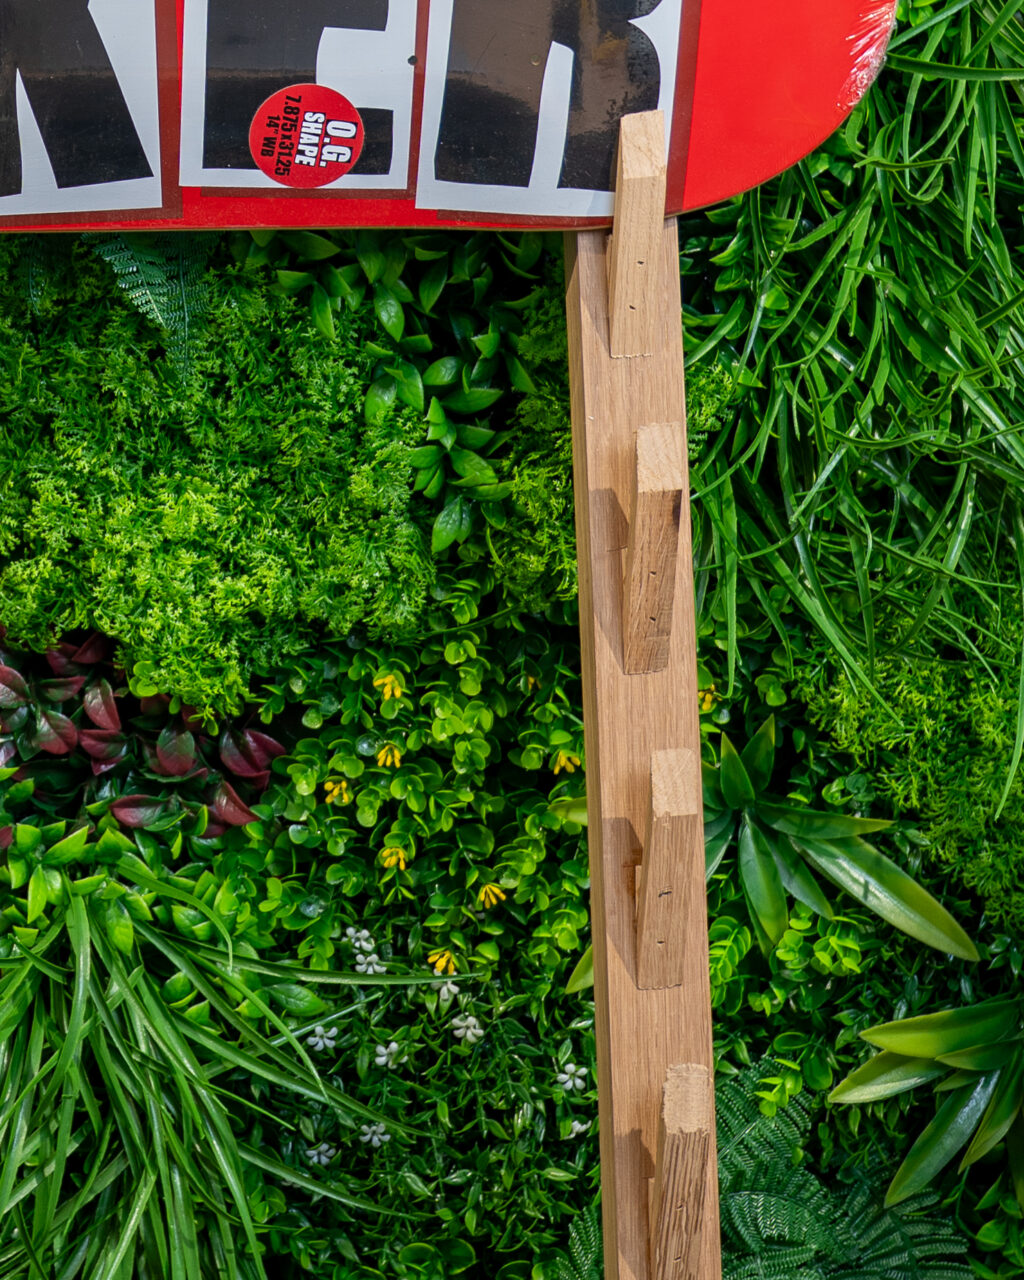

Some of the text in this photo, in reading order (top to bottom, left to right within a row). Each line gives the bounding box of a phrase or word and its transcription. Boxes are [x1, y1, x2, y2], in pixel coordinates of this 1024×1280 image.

[260, 136, 276, 158] WB
[294, 111, 326, 167] SHAPE
[319, 119, 358, 167] O.G.
